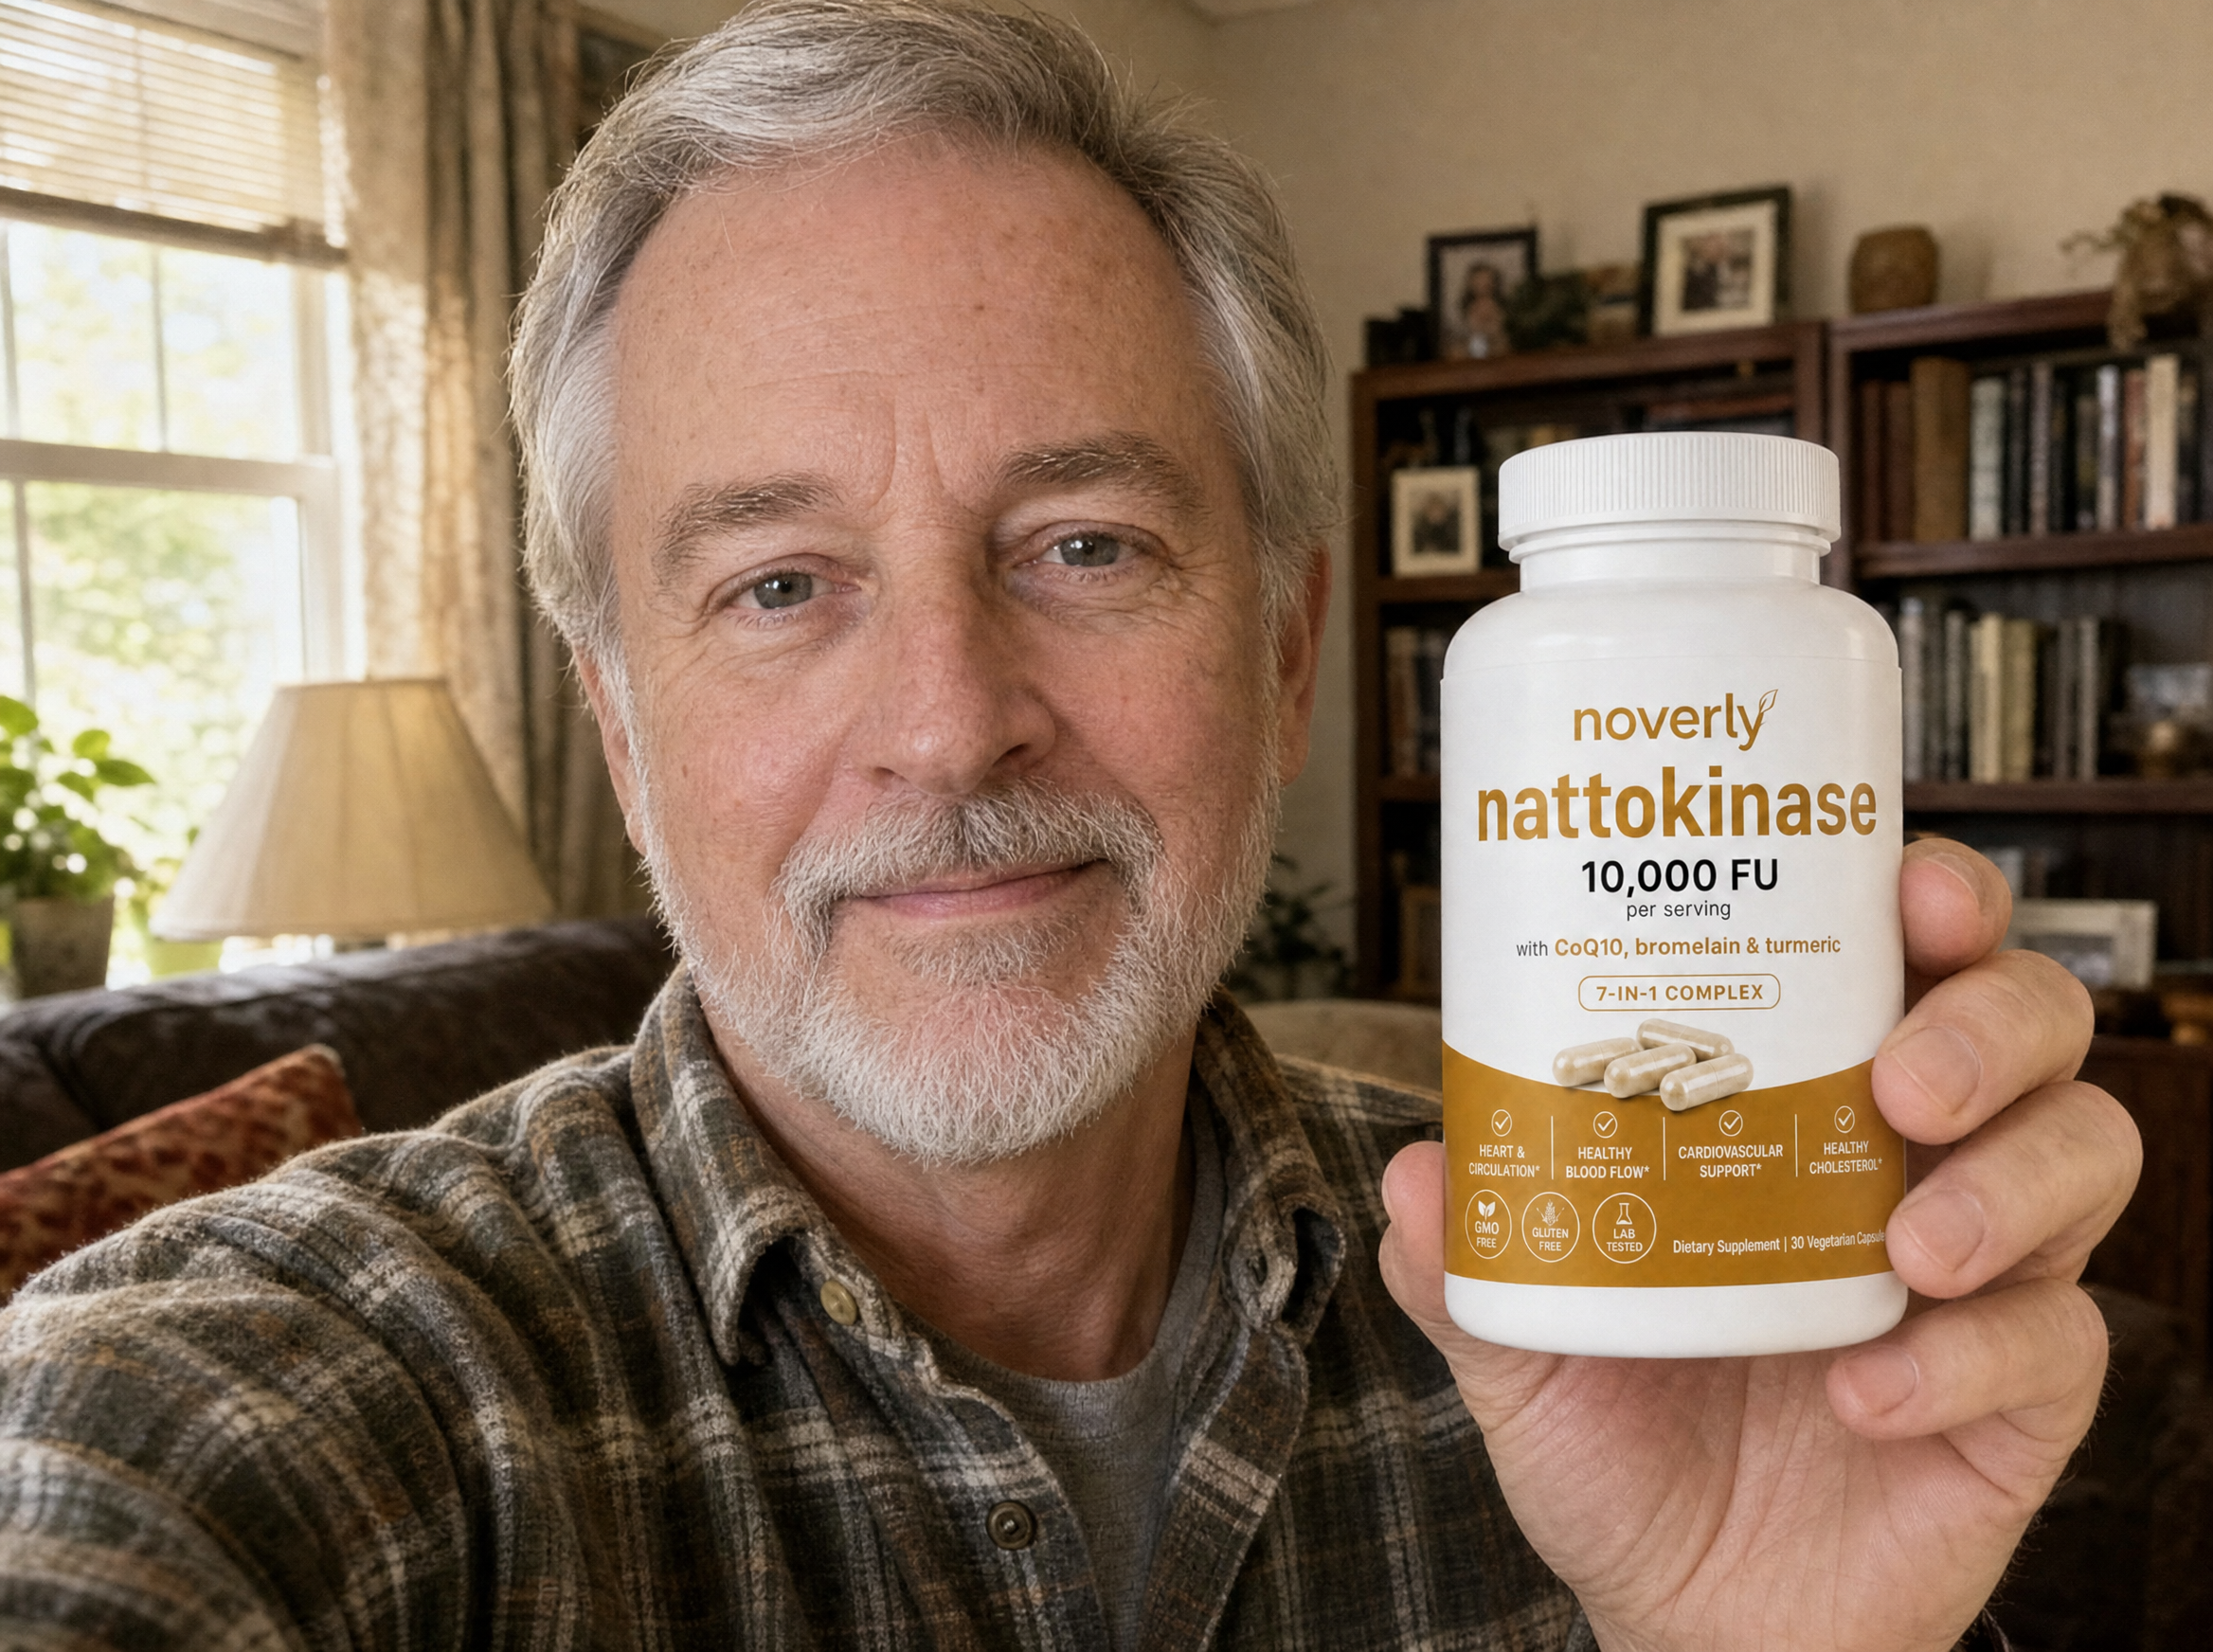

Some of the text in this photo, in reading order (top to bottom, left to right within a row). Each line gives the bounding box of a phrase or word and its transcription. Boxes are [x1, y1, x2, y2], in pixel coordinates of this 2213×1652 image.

[1574, 691, 1773, 751] noverly
[1478, 765, 1877, 841] nattokinase
[1581, 858, 1779, 898] 10,000 FU
[1627, 900, 1732, 922] per serving
[1516, 936, 1841, 960] with CoQ10, bromelain & turmeric
[1596, 984, 1764, 1002] 7-IN-1 COMPLEX
[1479, 1144, 1525, 1158] HEART &
[1577, 1146, 1632, 1160] HEALTHY
[1678, 1144, 1784, 1159] CARDIOVASCULAR
[1824, 1140, 1869, 1156] HEALTHY
[1565, 1165, 1607, 1179] BLOOD
[1474, 1220, 1500, 1235] GMO
[1532, 1227, 1569, 1239] GLUTEN
[1613, 1229, 1636, 1239] LAB
[1476, 1236, 1497, 1248] FREE
[1538, 1241, 1562, 1251] FREE
[1606, 1241, 1644, 1252] TESTED
[1672, 1239, 1715, 1257] Dietary
[1717, 1237, 1781, 1256] Supplement
[1790, 1235, 1805, 1249] 30
[1807, 1232, 1856, 1251] Vegetarian
[1857, 1229, 1886, 1247] Capsule
